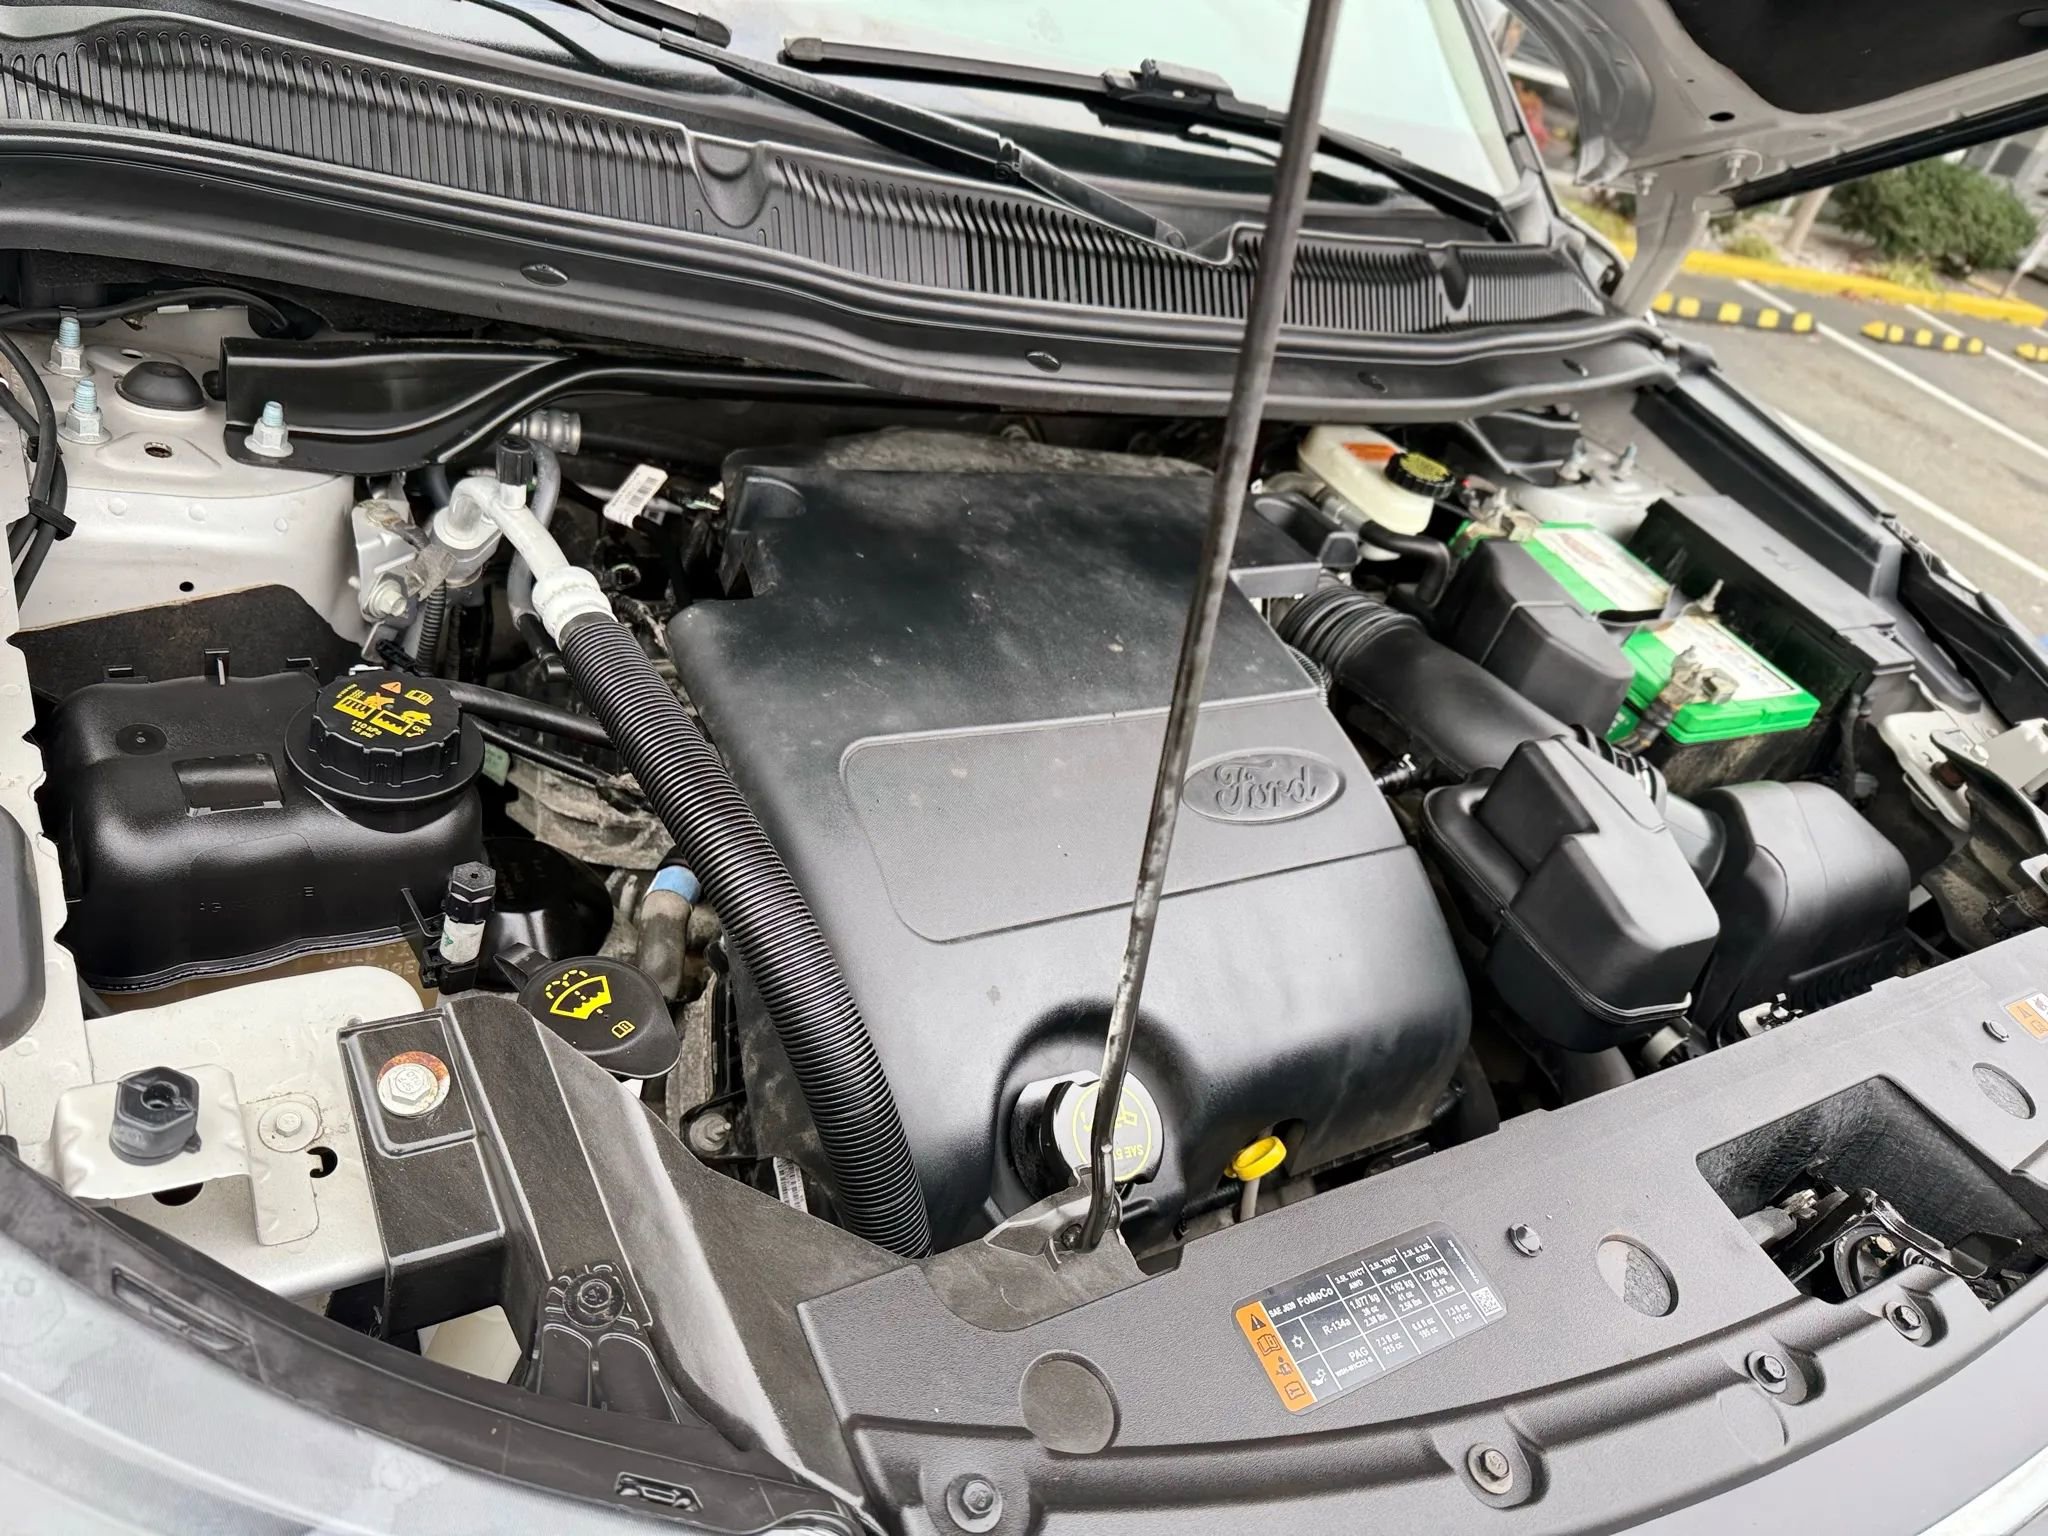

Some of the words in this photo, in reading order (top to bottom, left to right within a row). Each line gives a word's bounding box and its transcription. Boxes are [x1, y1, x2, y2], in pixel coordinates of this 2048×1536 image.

[412, 725, 427, 734] OK
[1214, 759, 1319, 815] Ford
[1125, 1144, 1144, 1158] SAE
[1382, 1266, 1397, 1277] FWD
[1435, 1266, 1448, 1276] kg
[1349, 1279, 1364, 1290] AWD
[1385, 1281, 1405, 1295] 1.162
[1402, 1279, 1415, 1289] kg
[1268, 1306, 1283, 1318] SAE
[1296, 1287, 1334, 1307] FoMoCo
[1349, 1295, 1369, 1310] 1.077
[1367, 1293, 1380, 1303] kg
[1322, 1318, 1352, 1336] R-134a
[1348, 1346, 1369, 1361] PAG
[1382, 1345, 1396, 1355] 215
